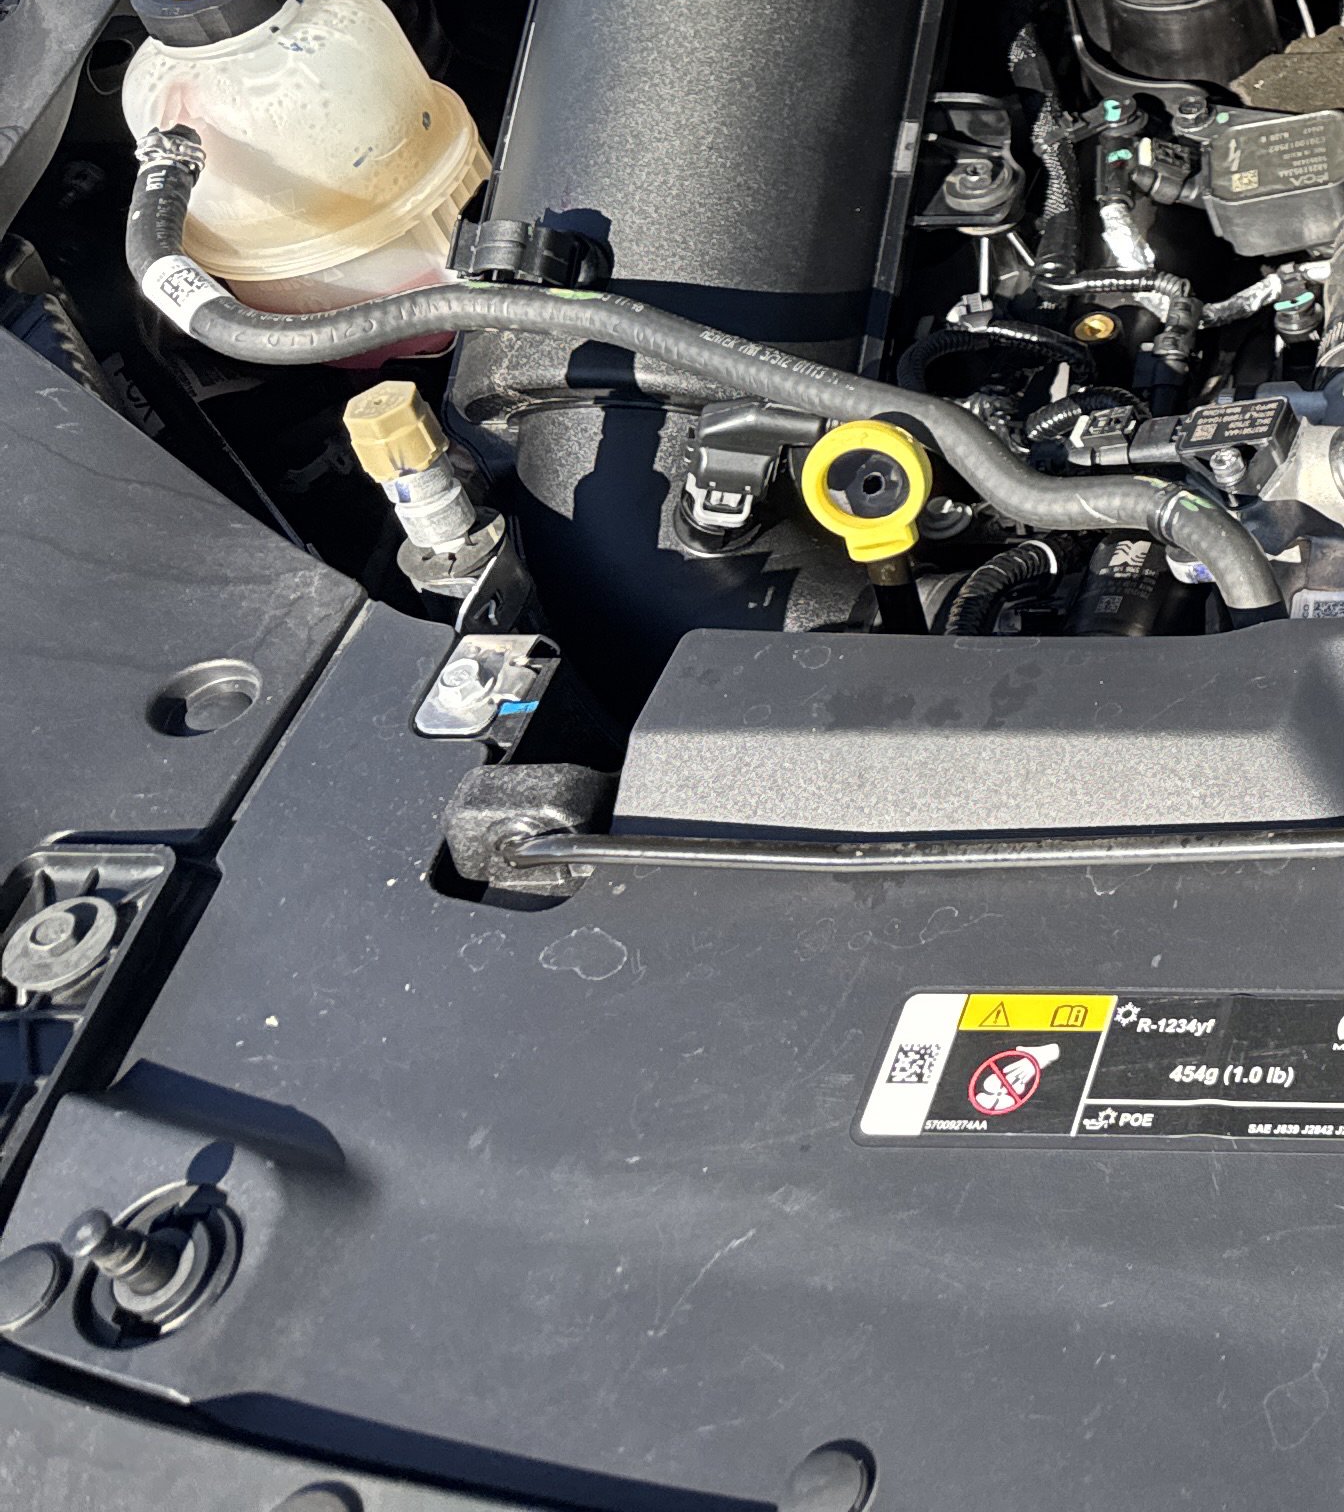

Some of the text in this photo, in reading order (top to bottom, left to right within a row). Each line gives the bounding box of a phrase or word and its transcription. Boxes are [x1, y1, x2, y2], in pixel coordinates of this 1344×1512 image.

[1137, 1015, 1215, 1037] R-1234yf
[1169, 1064, 1296, 1088] 454g (1.0 lb)
[1118, 1112, 1155, 1128] POE
[1247, 1123, 1273, 1135] SAE
